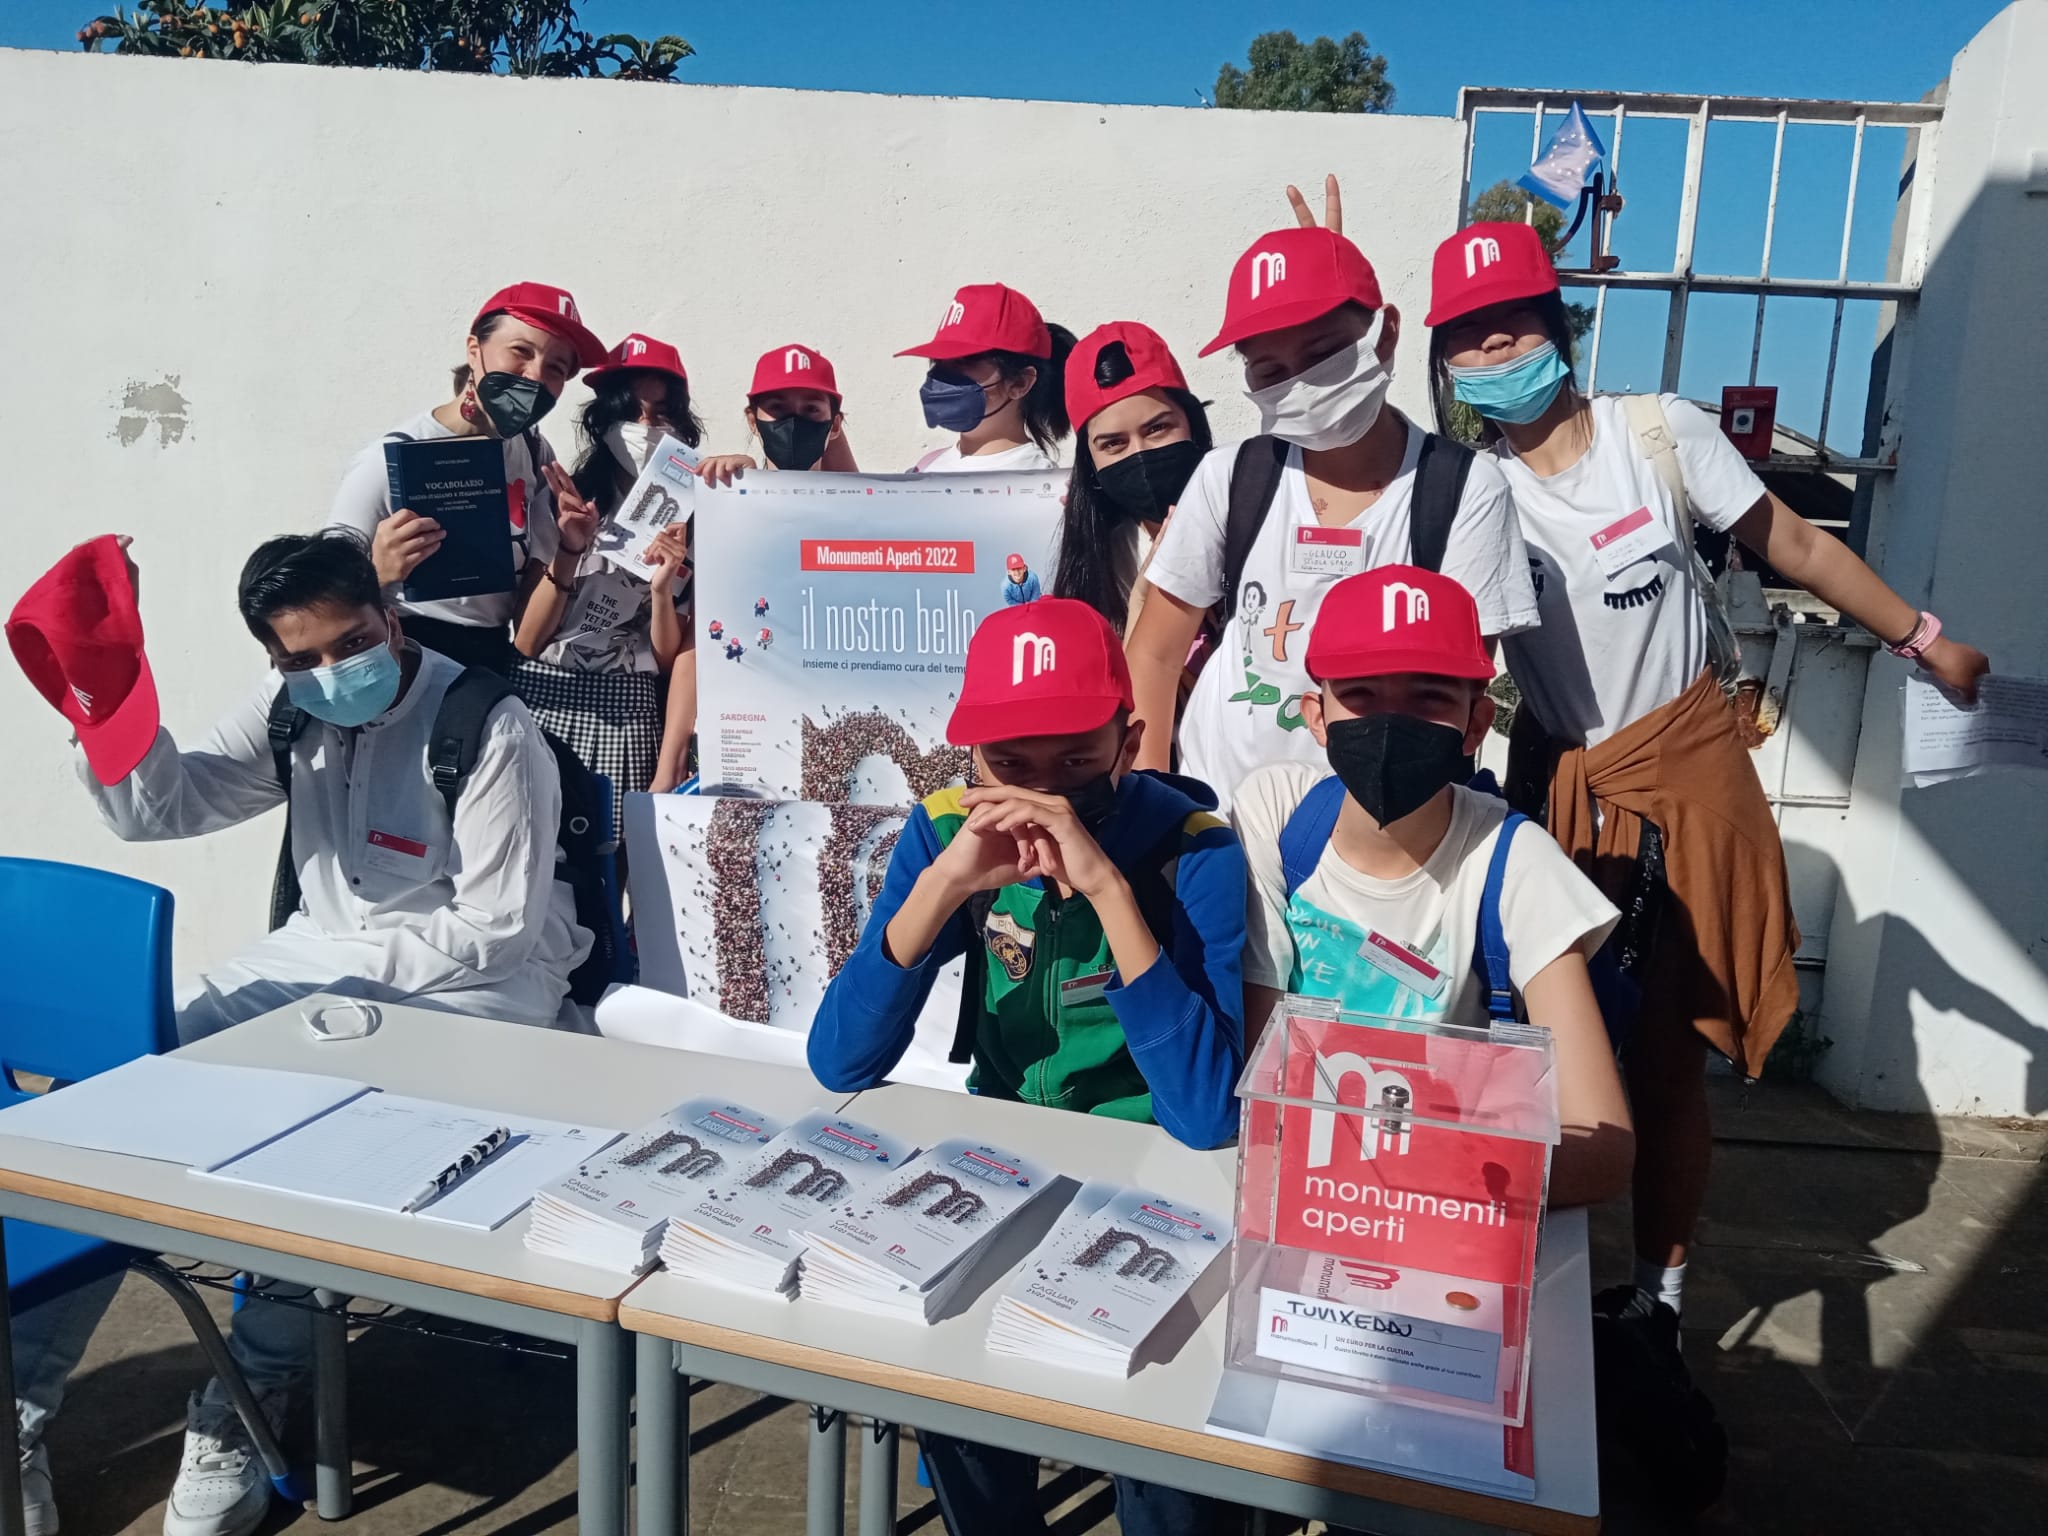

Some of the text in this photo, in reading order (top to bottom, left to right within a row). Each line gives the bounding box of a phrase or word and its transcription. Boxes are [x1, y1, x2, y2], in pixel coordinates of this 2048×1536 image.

[425, 480, 484, 490] VOCABOLARIO
[816, 546, 957, 569] Monumenti Aperti 2022
[587, 600, 620, 620] BEST IS
[601, 594, 618, 608] THE
[584, 612, 612, 628] YET TO
[802, 587, 976, 656] il nostro bello
[803, 659, 839, 670] Insieme
[841, 660, 849, 670] ci
[851, 661, 903, 672] prendiamo
[904, 664, 925, 673] cura
[928, 663, 942, 673] del
[720, 713, 767, 721] SARDEGNA
[1305, 1175, 1506, 1228] monumenti
[699, 1202, 745, 1224] CAGLIARI
[835, 1219, 878, 1241] CAGLIARI
[1302, 1207, 1404, 1243] aperti
[1031, 1282, 1079, 1306] CAGLIARI
[1347, 1338, 1364, 1347] EURO
[1387, 1346, 1414, 1357] CULTURA
